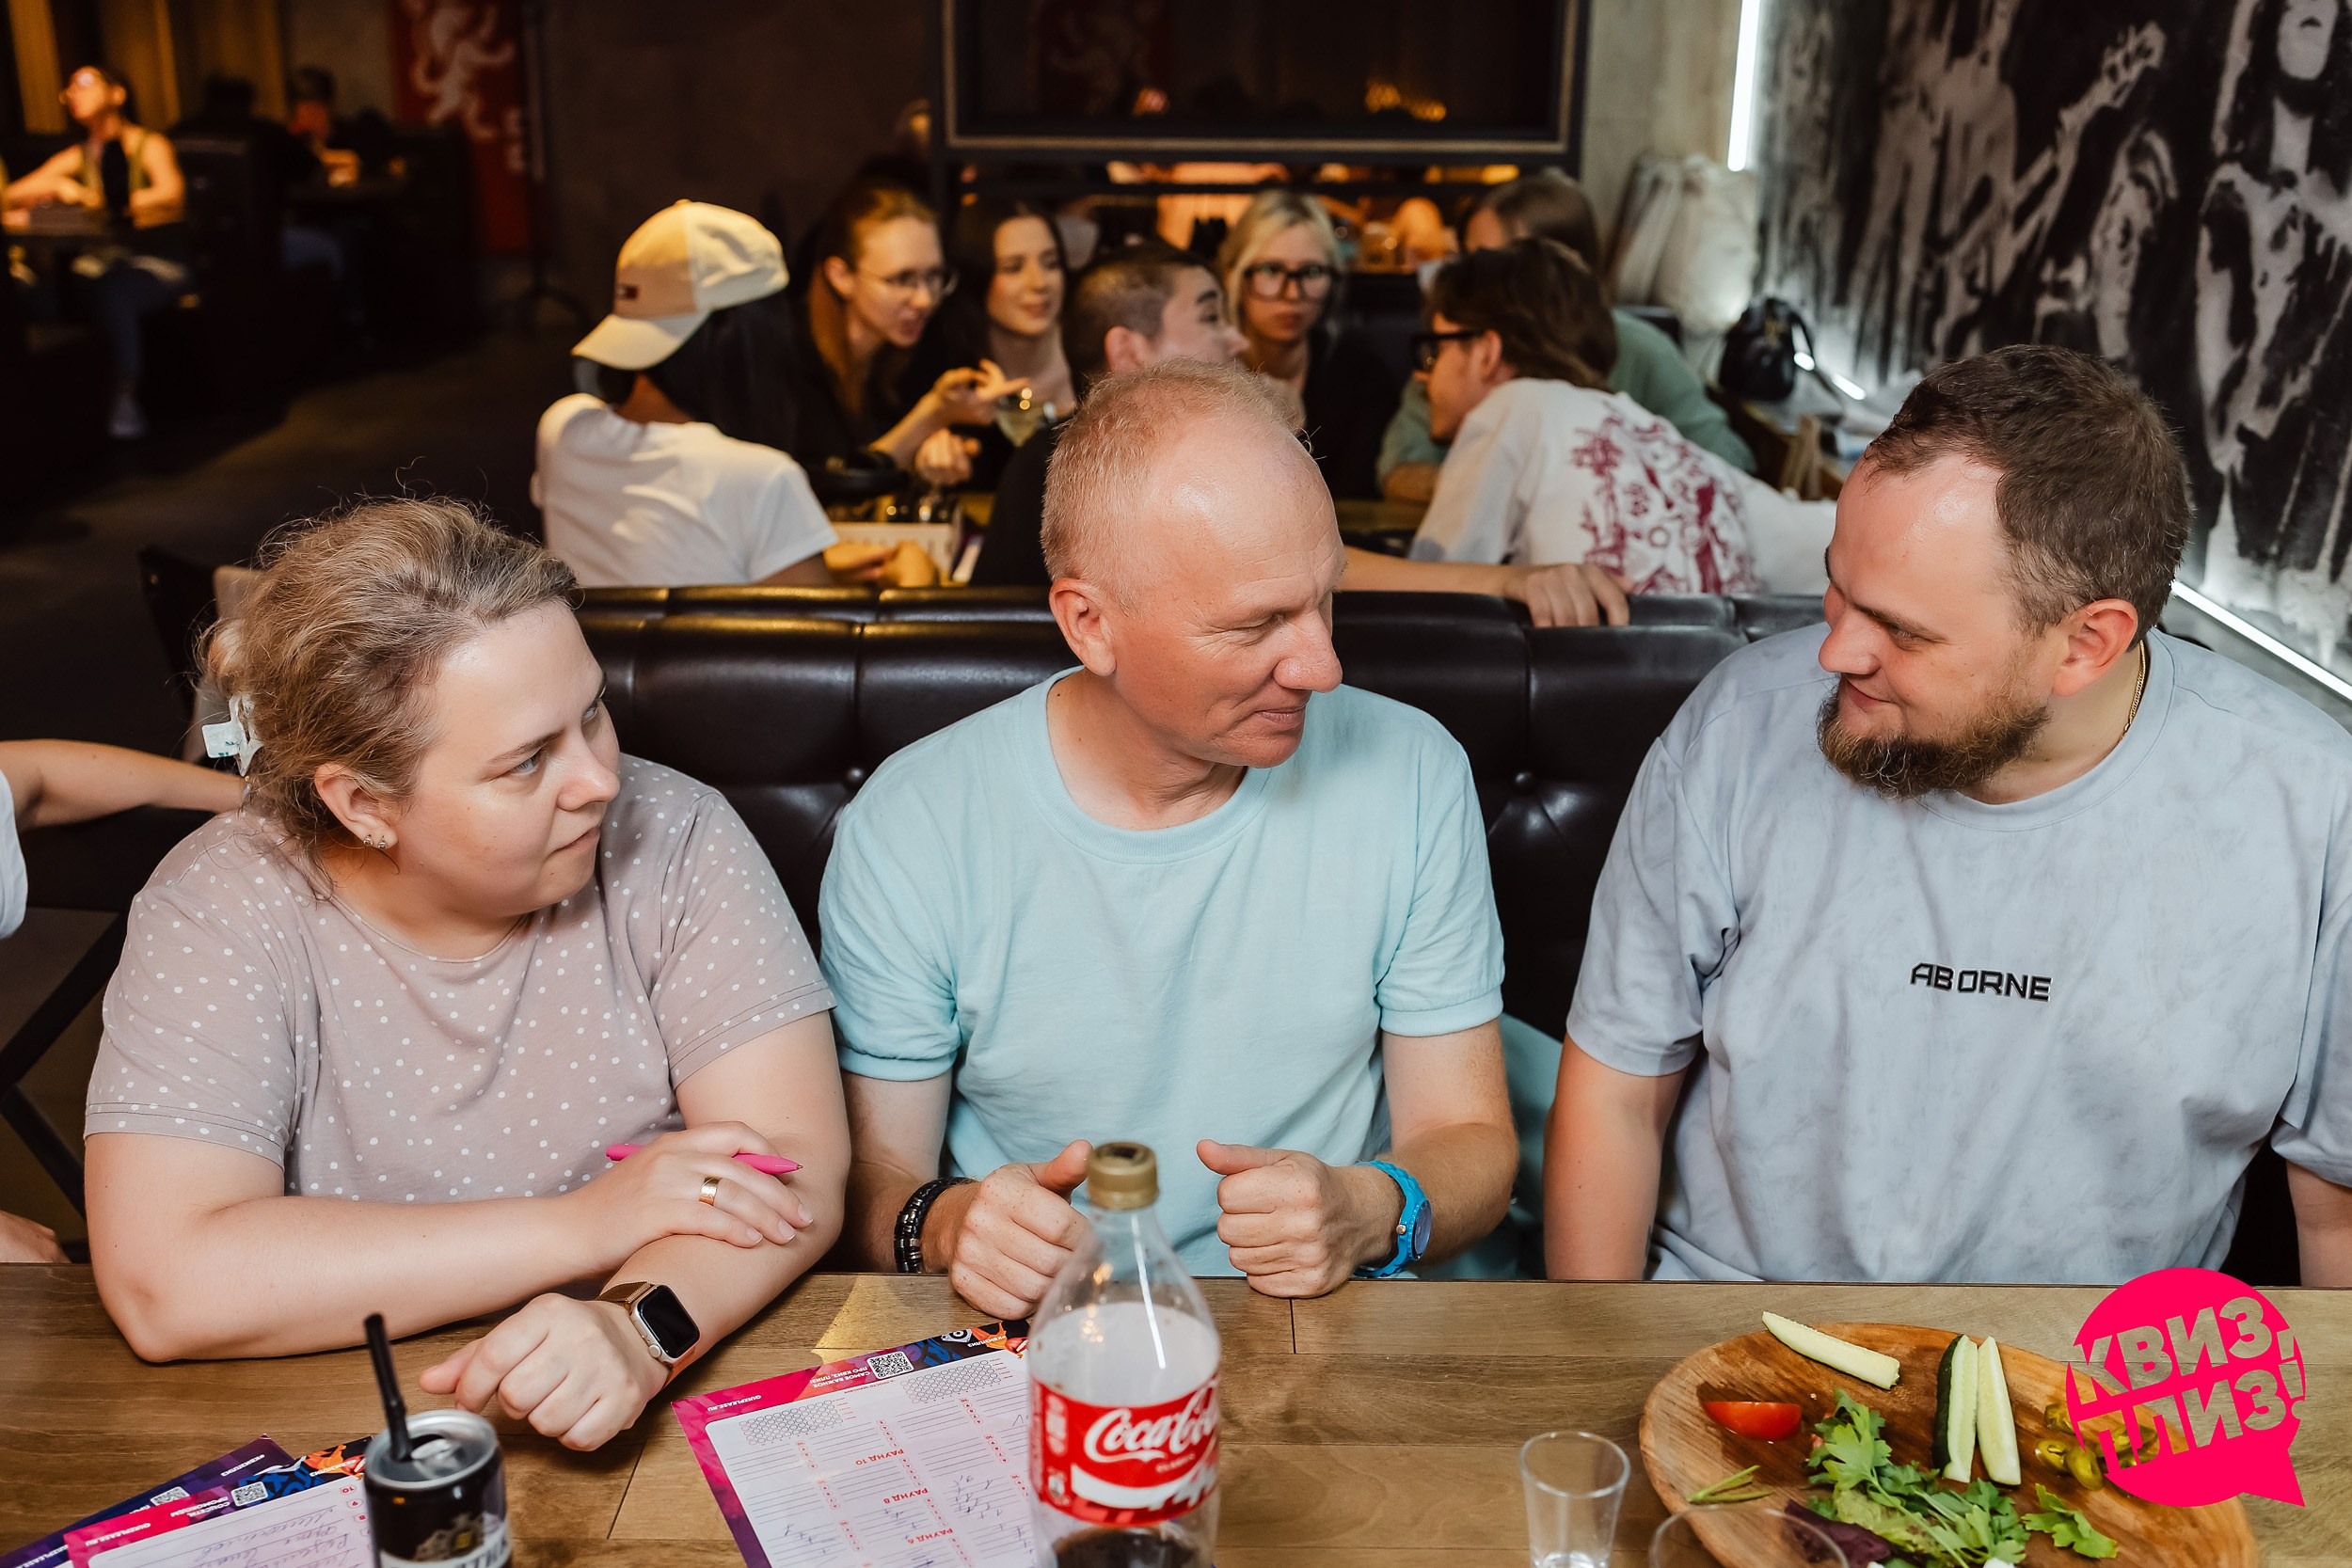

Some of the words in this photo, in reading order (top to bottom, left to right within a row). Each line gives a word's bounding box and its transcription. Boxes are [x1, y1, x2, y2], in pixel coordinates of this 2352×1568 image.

[1910, 962, 2053, 1003] ABORNE
[845, 1370, 871, 1381] САМОЕ
[813, 1378, 845, 1388] ВАЖНОЕ
[707, 1395, 761, 1412] QUIZPLEASE.RU
[868, 1449, 905, 1462] РАУНД
[892, 1488, 929, 1502] РАУНД
[916, 1528, 954, 1543] РАУНД
